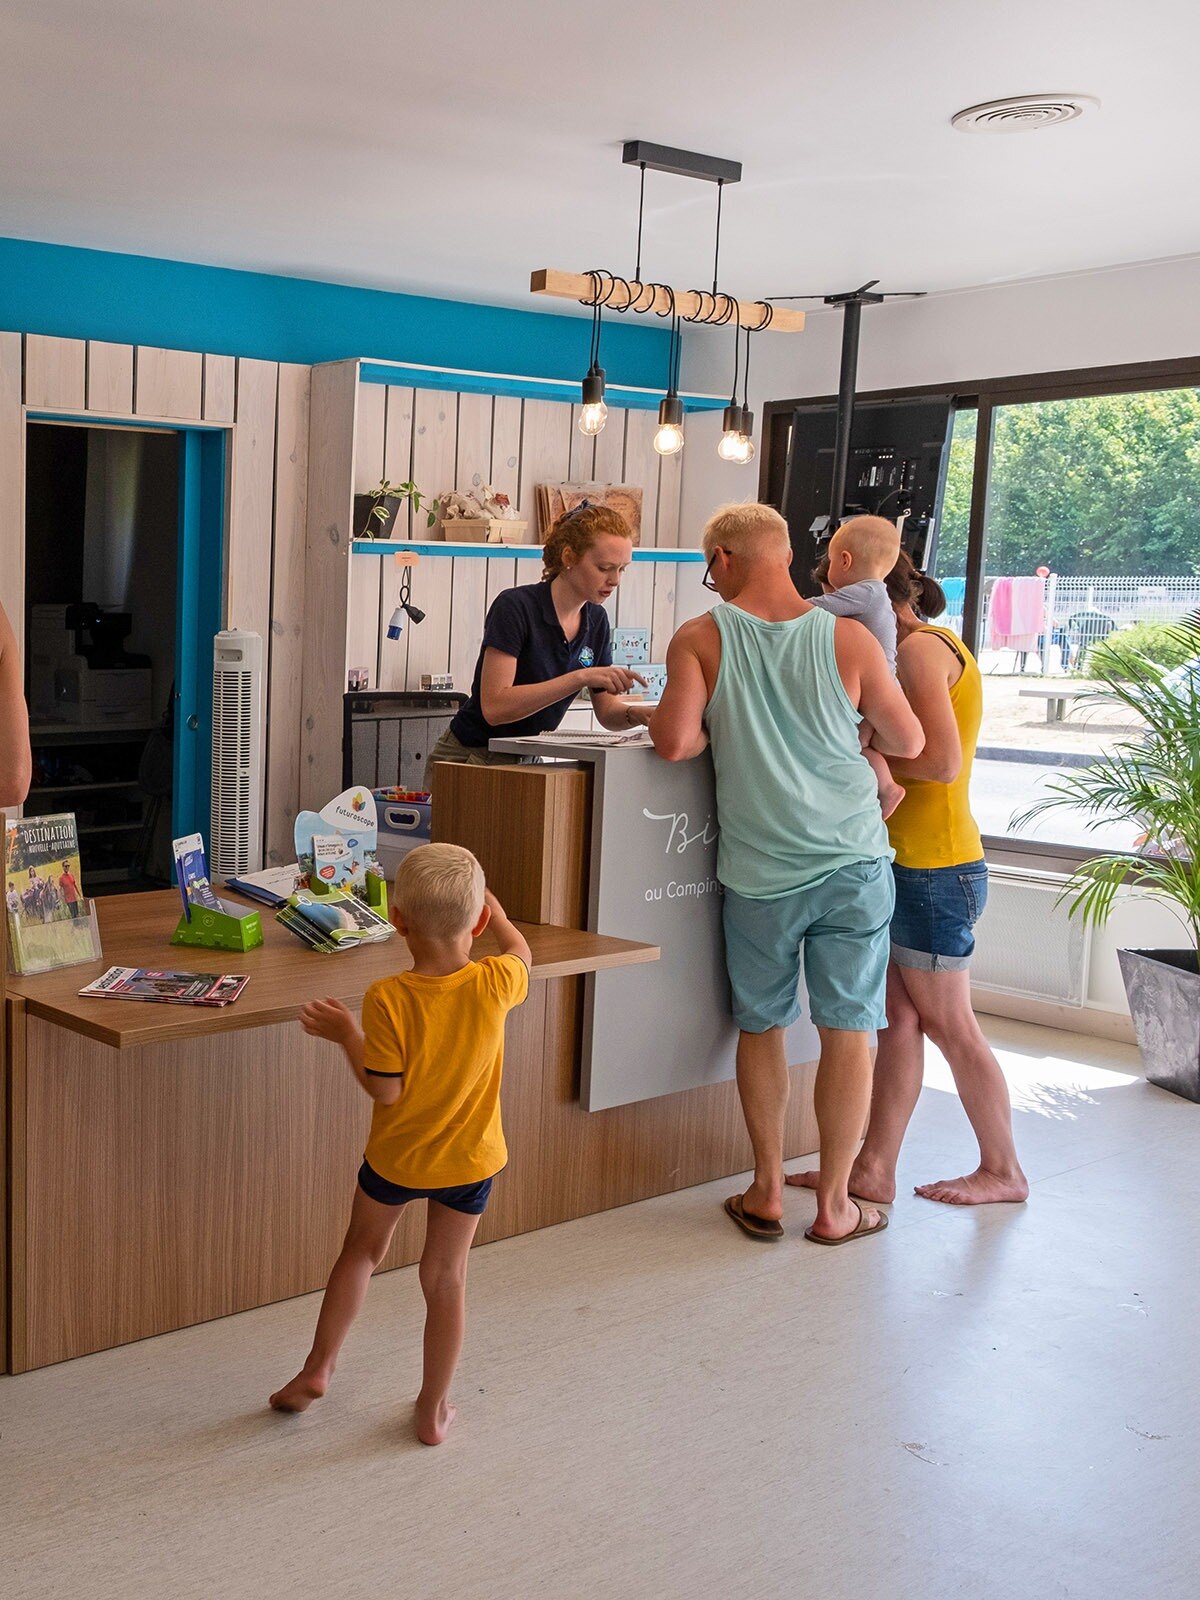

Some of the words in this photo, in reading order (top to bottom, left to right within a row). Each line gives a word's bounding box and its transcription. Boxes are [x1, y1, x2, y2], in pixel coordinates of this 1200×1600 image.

[335, 806, 374, 826] futuroscope
[24, 825, 74, 843] DESTINATION
[642, 807, 721, 854] Bi
[644, 887, 662, 901] au
